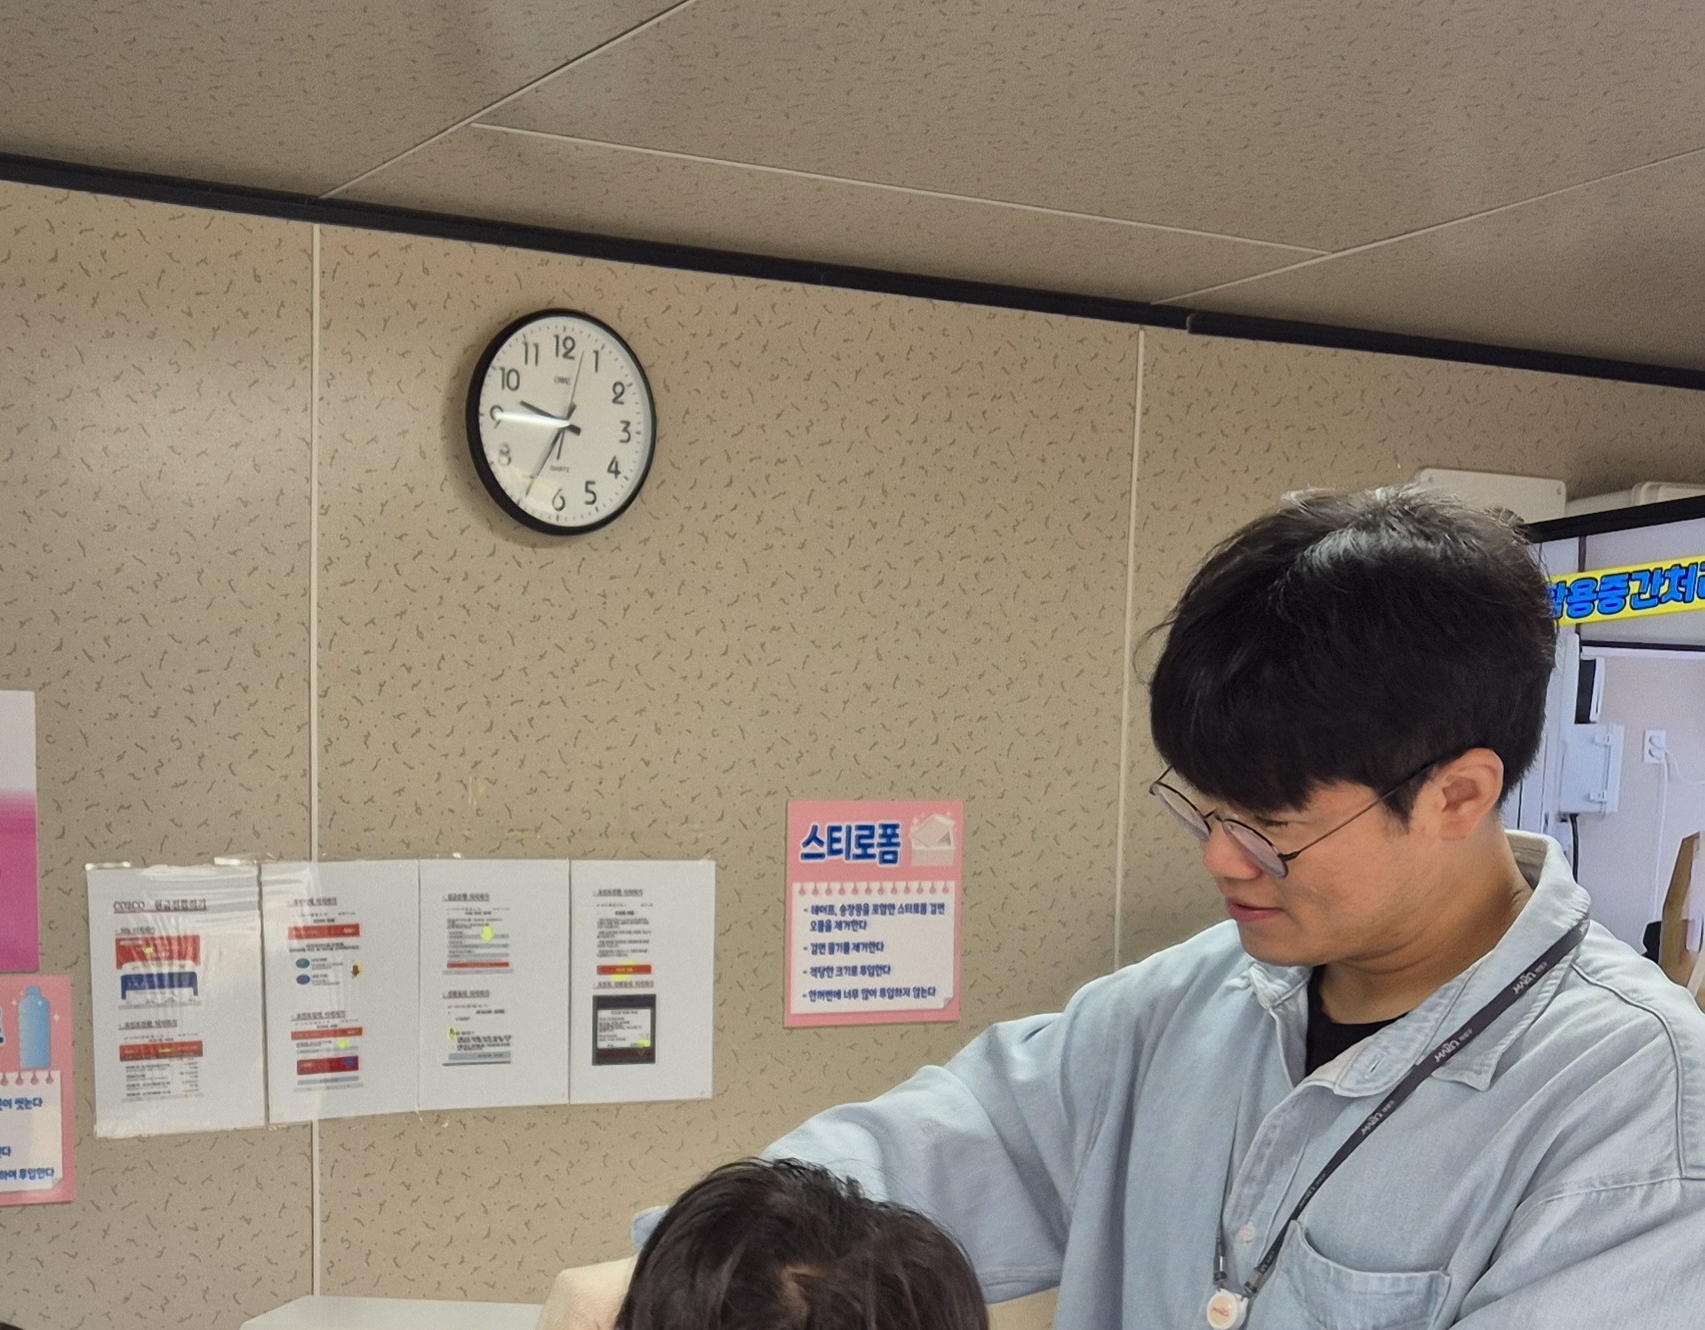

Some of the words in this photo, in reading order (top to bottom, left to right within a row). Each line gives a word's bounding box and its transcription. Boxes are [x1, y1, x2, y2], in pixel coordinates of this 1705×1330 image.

[524, 342, 539, 367] 11
[554, 334, 576, 360] 12
[499, 367, 521, 391] 10
[612, 381, 626, 405] 2
[619, 420, 631, 444] 3
[498, 442, 512, 467] 8
[607, 455, 621, 479] 4
[552, 488, 566, 512] 6
[584, 480, 598, 505] 5
[801, 823, 901, 864] 스티로폼
[18, 1167, 55, 1180] 투입한다
